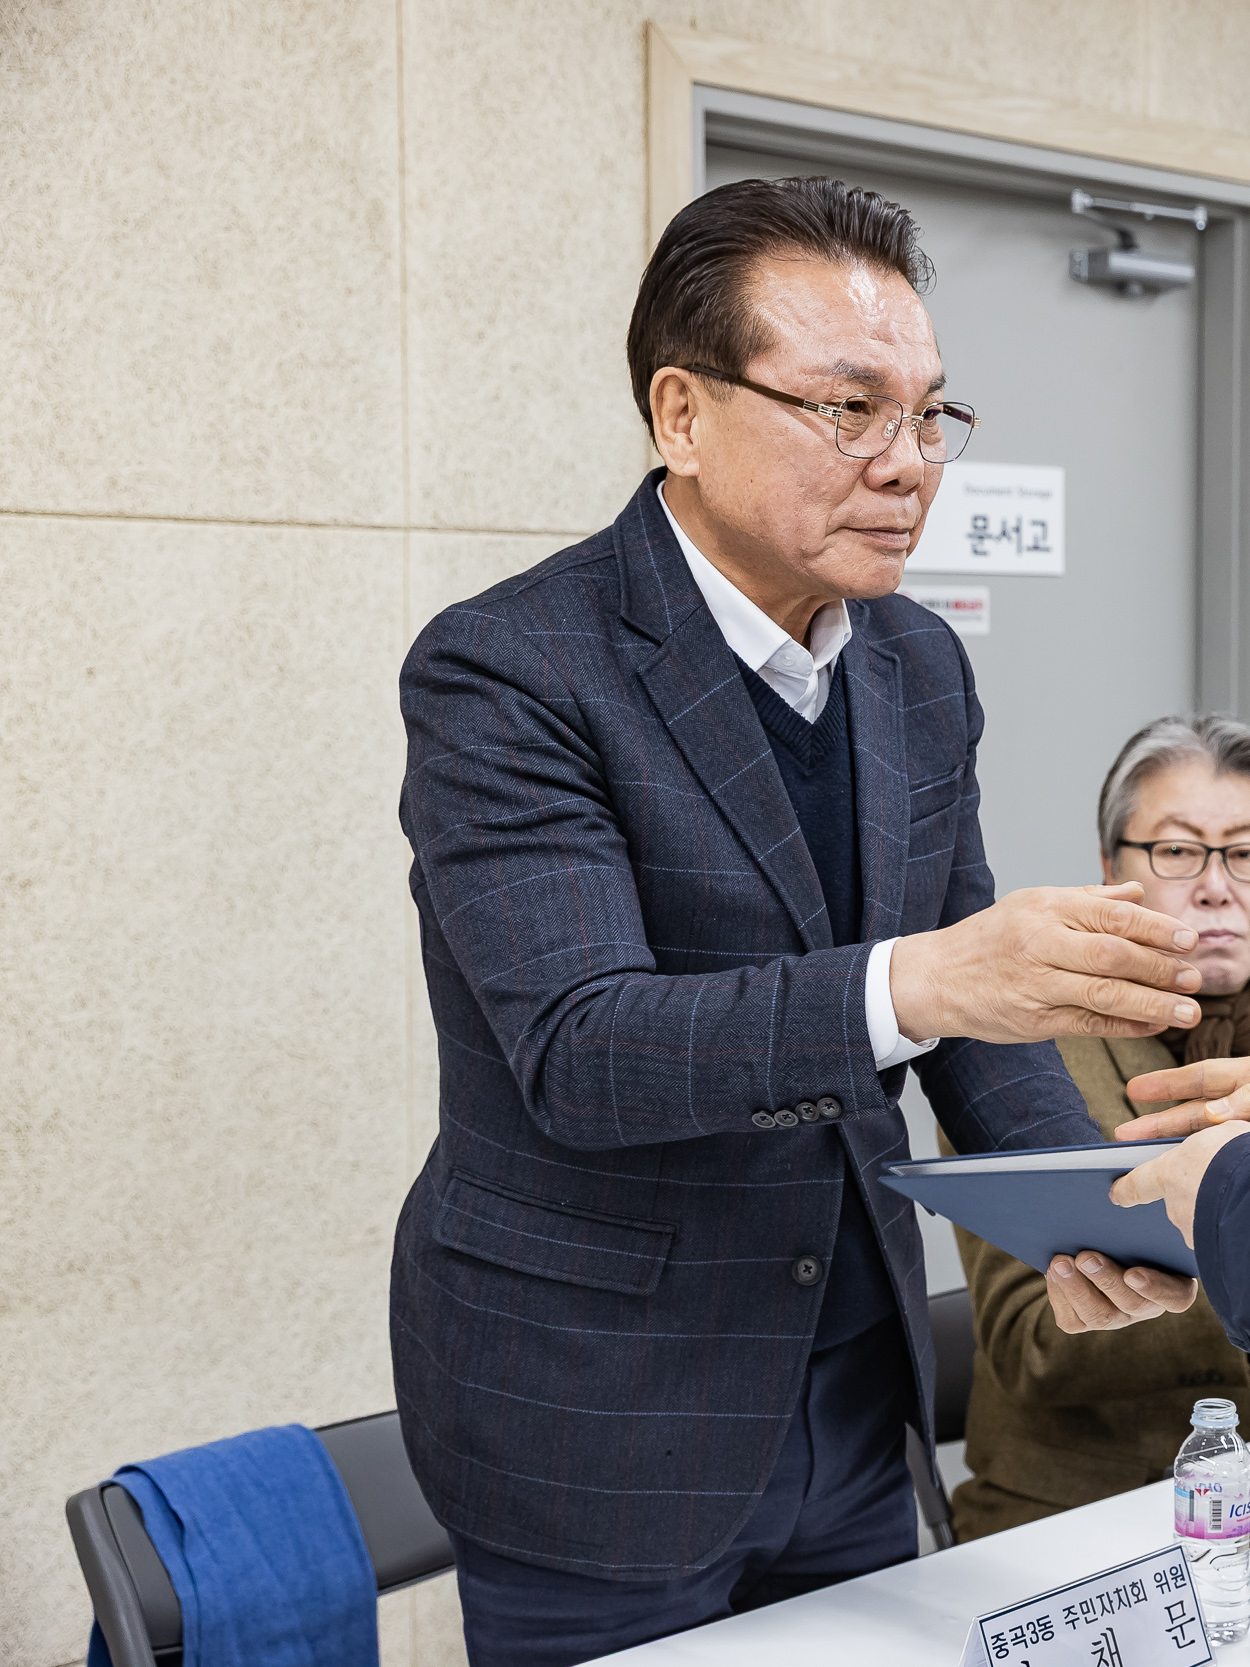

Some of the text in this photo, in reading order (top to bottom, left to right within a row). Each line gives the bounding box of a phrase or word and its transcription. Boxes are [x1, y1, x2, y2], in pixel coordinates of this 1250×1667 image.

[966, 515, 1053, 556] 문서고
[990, 1563, 1187, 1659] 중곡3동 주민자치회 위원
[1164, 1600, 1196, 1649] 문
